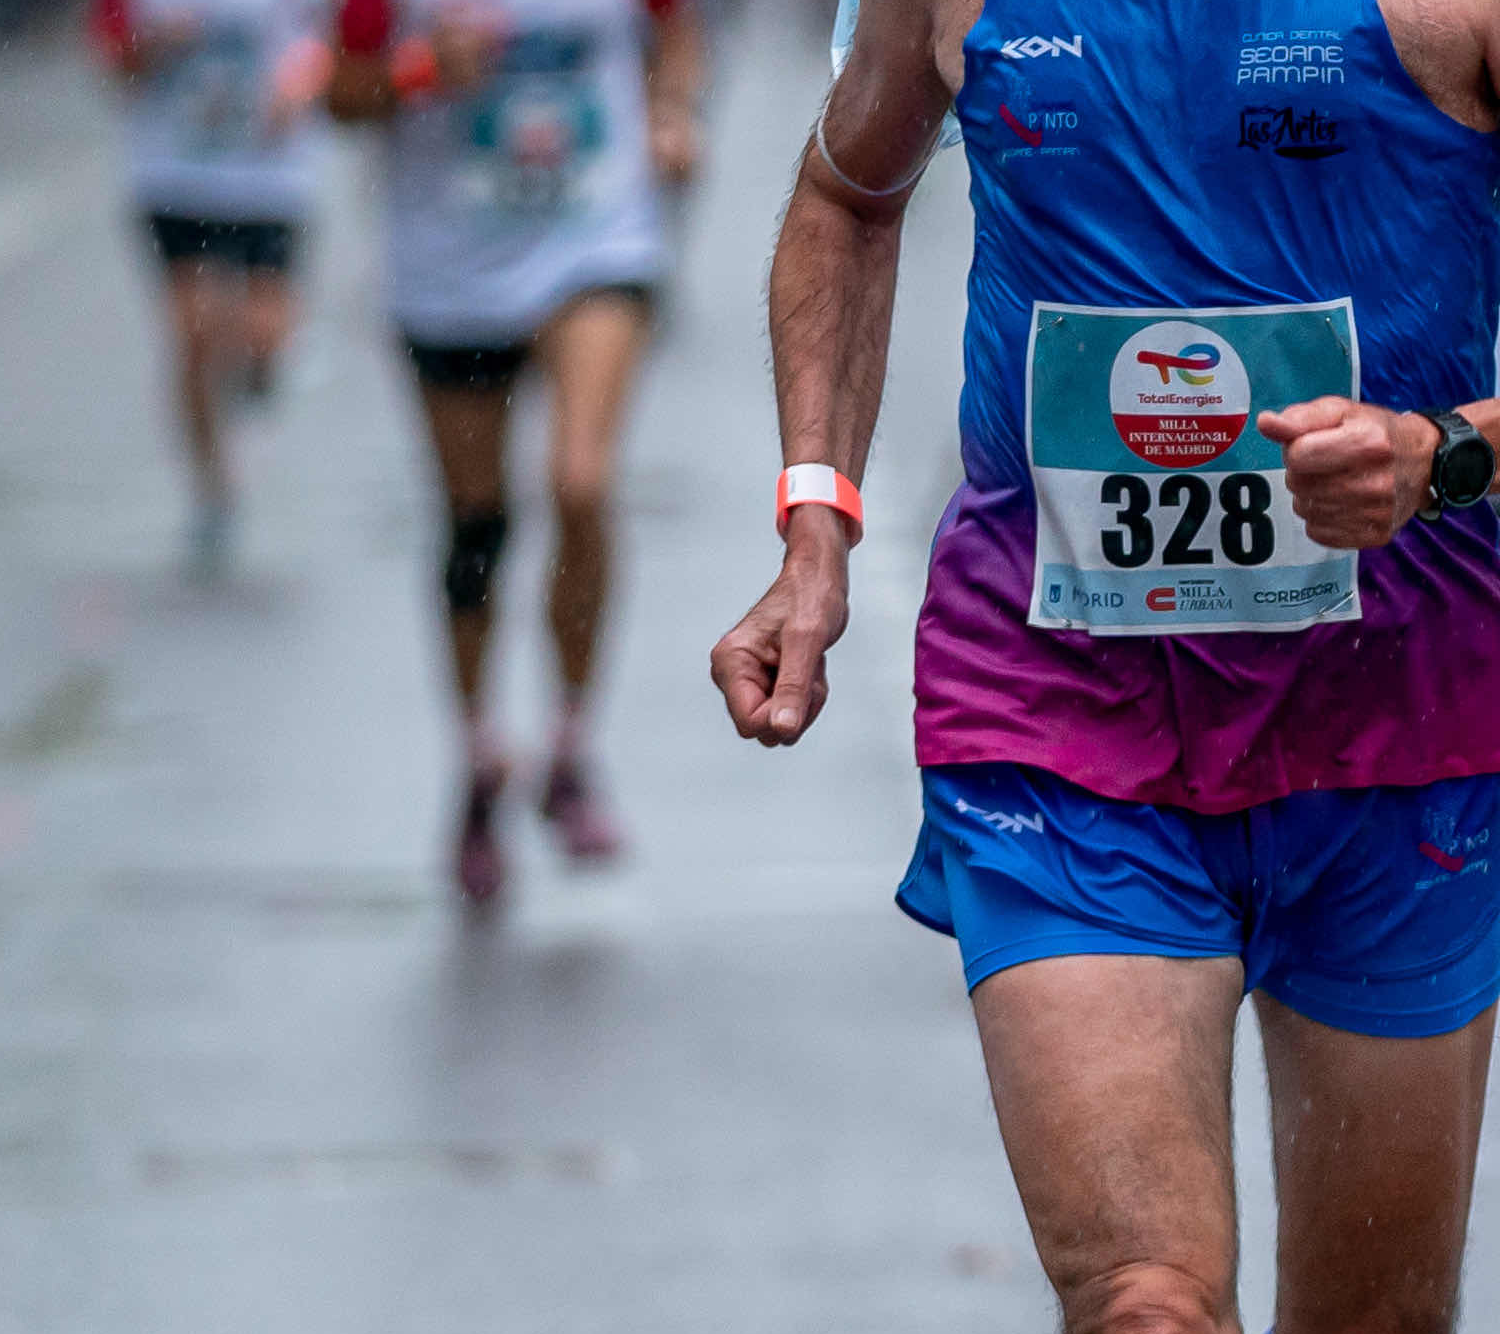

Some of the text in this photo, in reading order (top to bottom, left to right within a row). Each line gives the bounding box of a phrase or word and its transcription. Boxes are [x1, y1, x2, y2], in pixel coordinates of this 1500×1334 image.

[1240, 45, 1344, 64] SEOANE
[1237, 66, 1345, 85] PAMPIN
[1136, 393, 1223, 407] TotalEnergies
[1159, 419, 1199, 430] MILLA
[1145, 445, 1216, 455] DE MADRID
[1100, 472, 1275, 569] 328
[1179, 586, 1226, 597] MILLA
